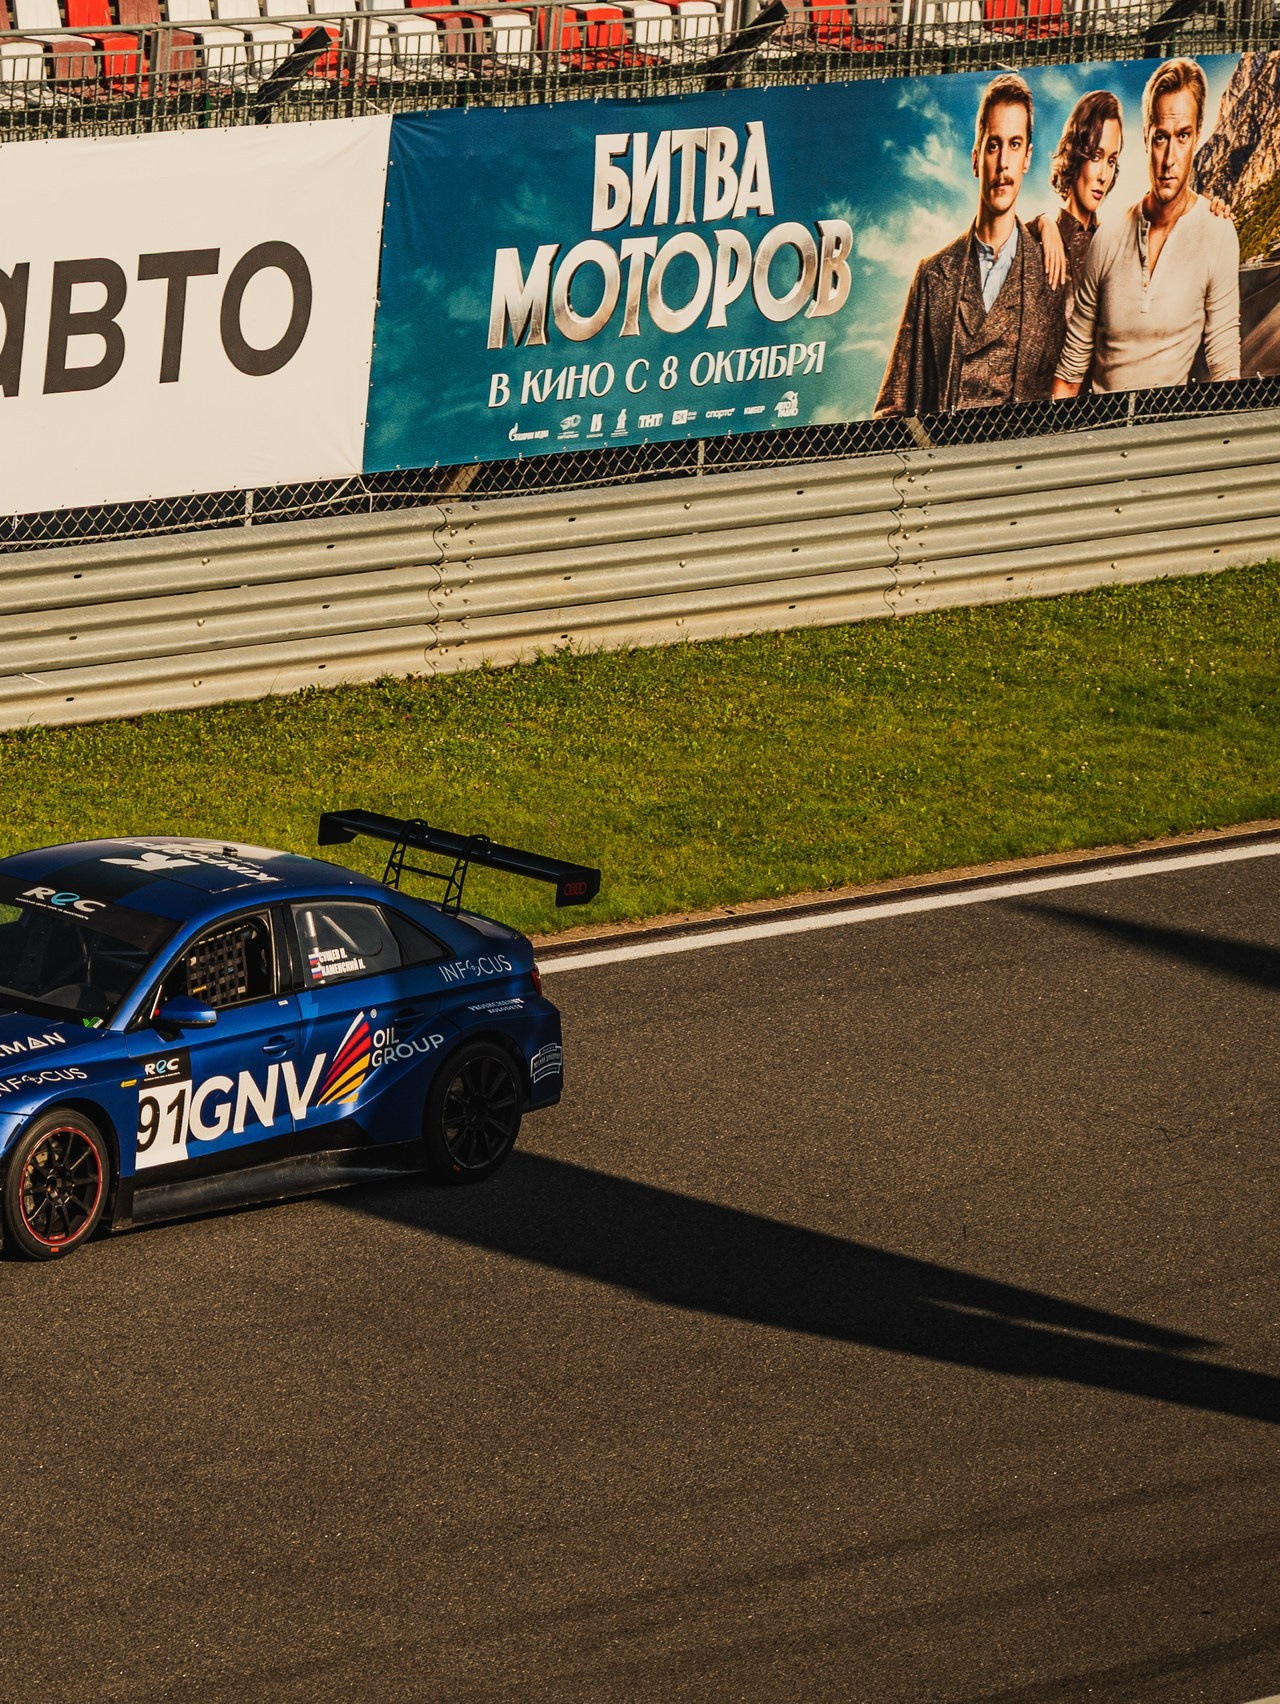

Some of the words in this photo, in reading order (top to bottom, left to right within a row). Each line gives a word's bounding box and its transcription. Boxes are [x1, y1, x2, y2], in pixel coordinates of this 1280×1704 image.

[591, 121, 774, 231] БИТВА
[486, 219, 853, 349] МОТОРОВ
[488, 373, 510, 408] В
[520, 361, 614, 404] КИНО
[625, 358, 649, 393] С
[659, 355, 678, 390] 8
[689, 341, 826, 386] ОКТЯБРЯ
[638, 413, 663, 428] ТНТ
[371, 1033, 445, 1067] GROUP
[372, 1026, 400, 1049] OIL
[136, 1088, 186, 1153] 91
[188, 1052, 327, 1142] GNV
